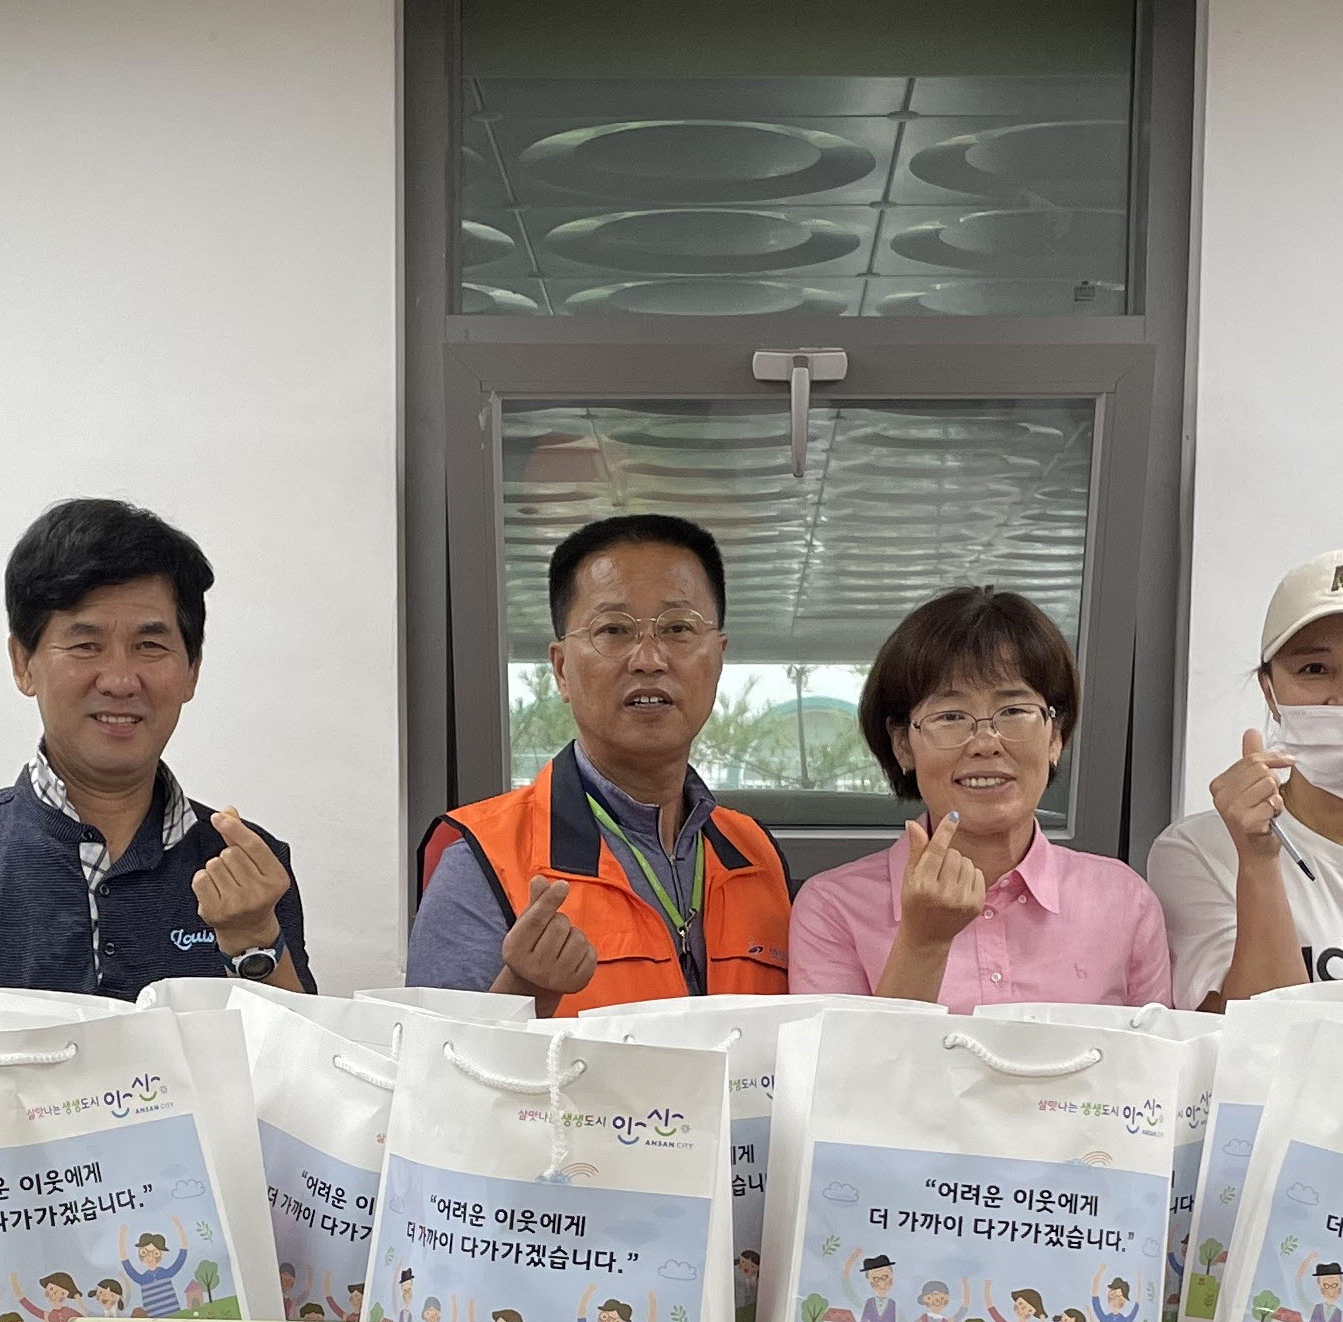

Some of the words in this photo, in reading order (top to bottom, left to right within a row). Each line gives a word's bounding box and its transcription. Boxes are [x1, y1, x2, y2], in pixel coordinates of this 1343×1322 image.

[170, 928, 215, 951] Louis
[27, 1103, 61, 1120] 살맛나는
[62, 1095, 99, 1115] 생생도시
[561, 1112, 607, 1128] 생생도시
[1037, 1099, 1078, 1114] 살맛나는
[1080, 1102, 1119, 1117] 생생도시
[644, 1139, 675, 1148] ANSAN
[19, 1161, 103, 1197] 이웃에게
[267, 1185, 278, 1208] 더
[280, 1193, 314, 1229] 가까이
[1013, 1186, 1099, 1217] 이웃에게
[406, 1221, 416, 1243] 더
[418, 1224, 454, 1254] 가까이
[494, 1206, 587, 1238] 이웃에게
[869, 1206, 889, 1231] 더
[898, 1210, 963, 1239] 가까이
